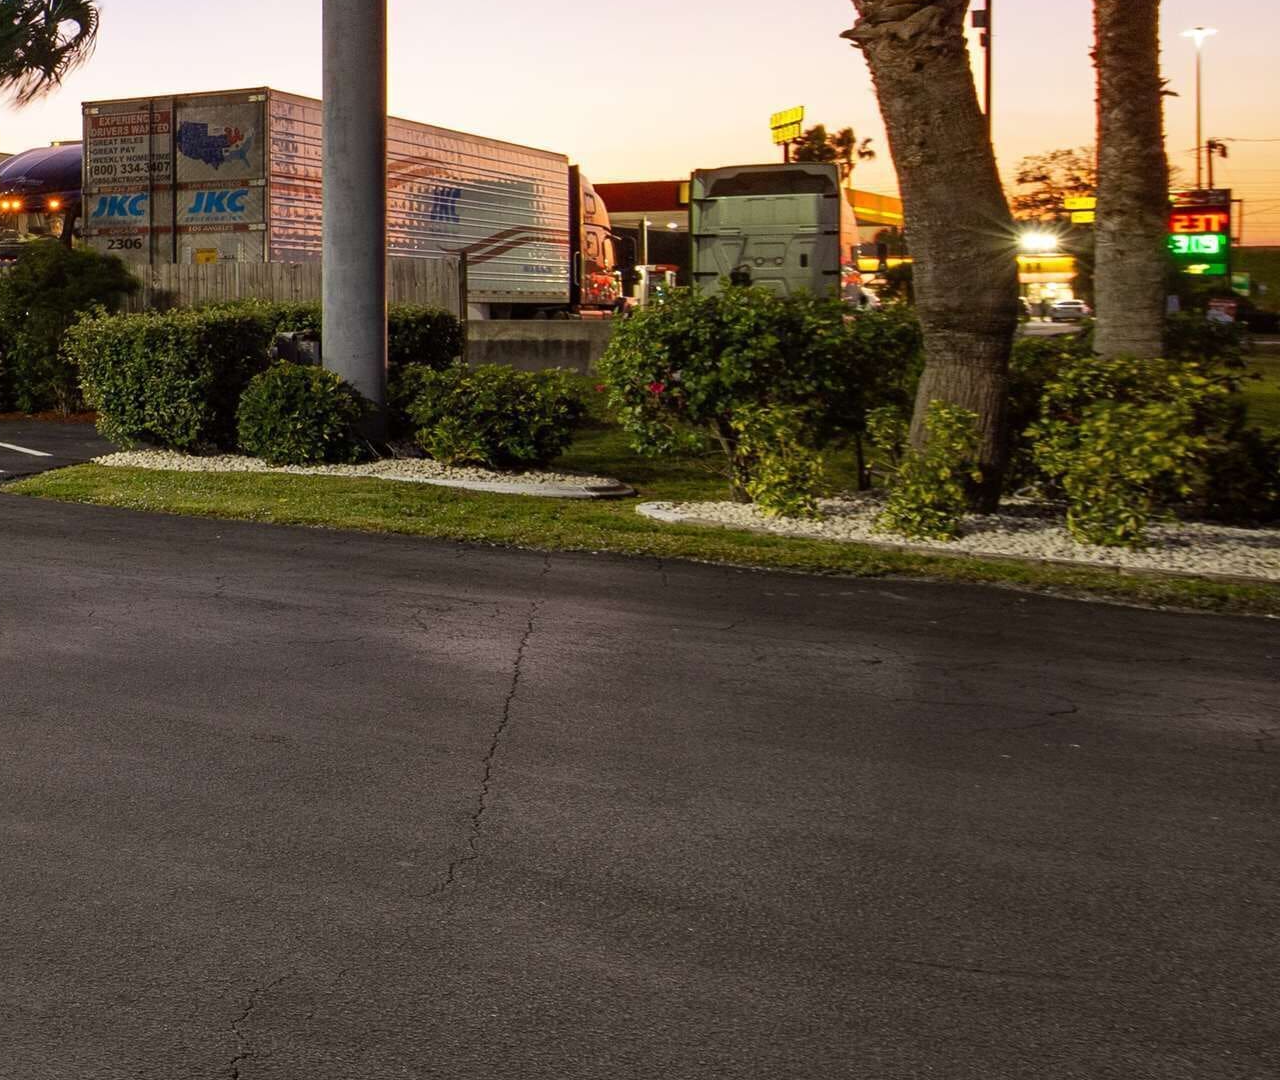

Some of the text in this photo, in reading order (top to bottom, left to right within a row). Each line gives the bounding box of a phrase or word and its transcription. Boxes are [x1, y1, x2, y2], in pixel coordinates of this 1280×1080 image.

[91, 126, 129, 137] DRIVERS
[90, 164, 117, 177] (800)
[92, 193, 148, 217] JKC
[188, 189, 249, 213] JKC
[107, 238, 143, 250] 2306
